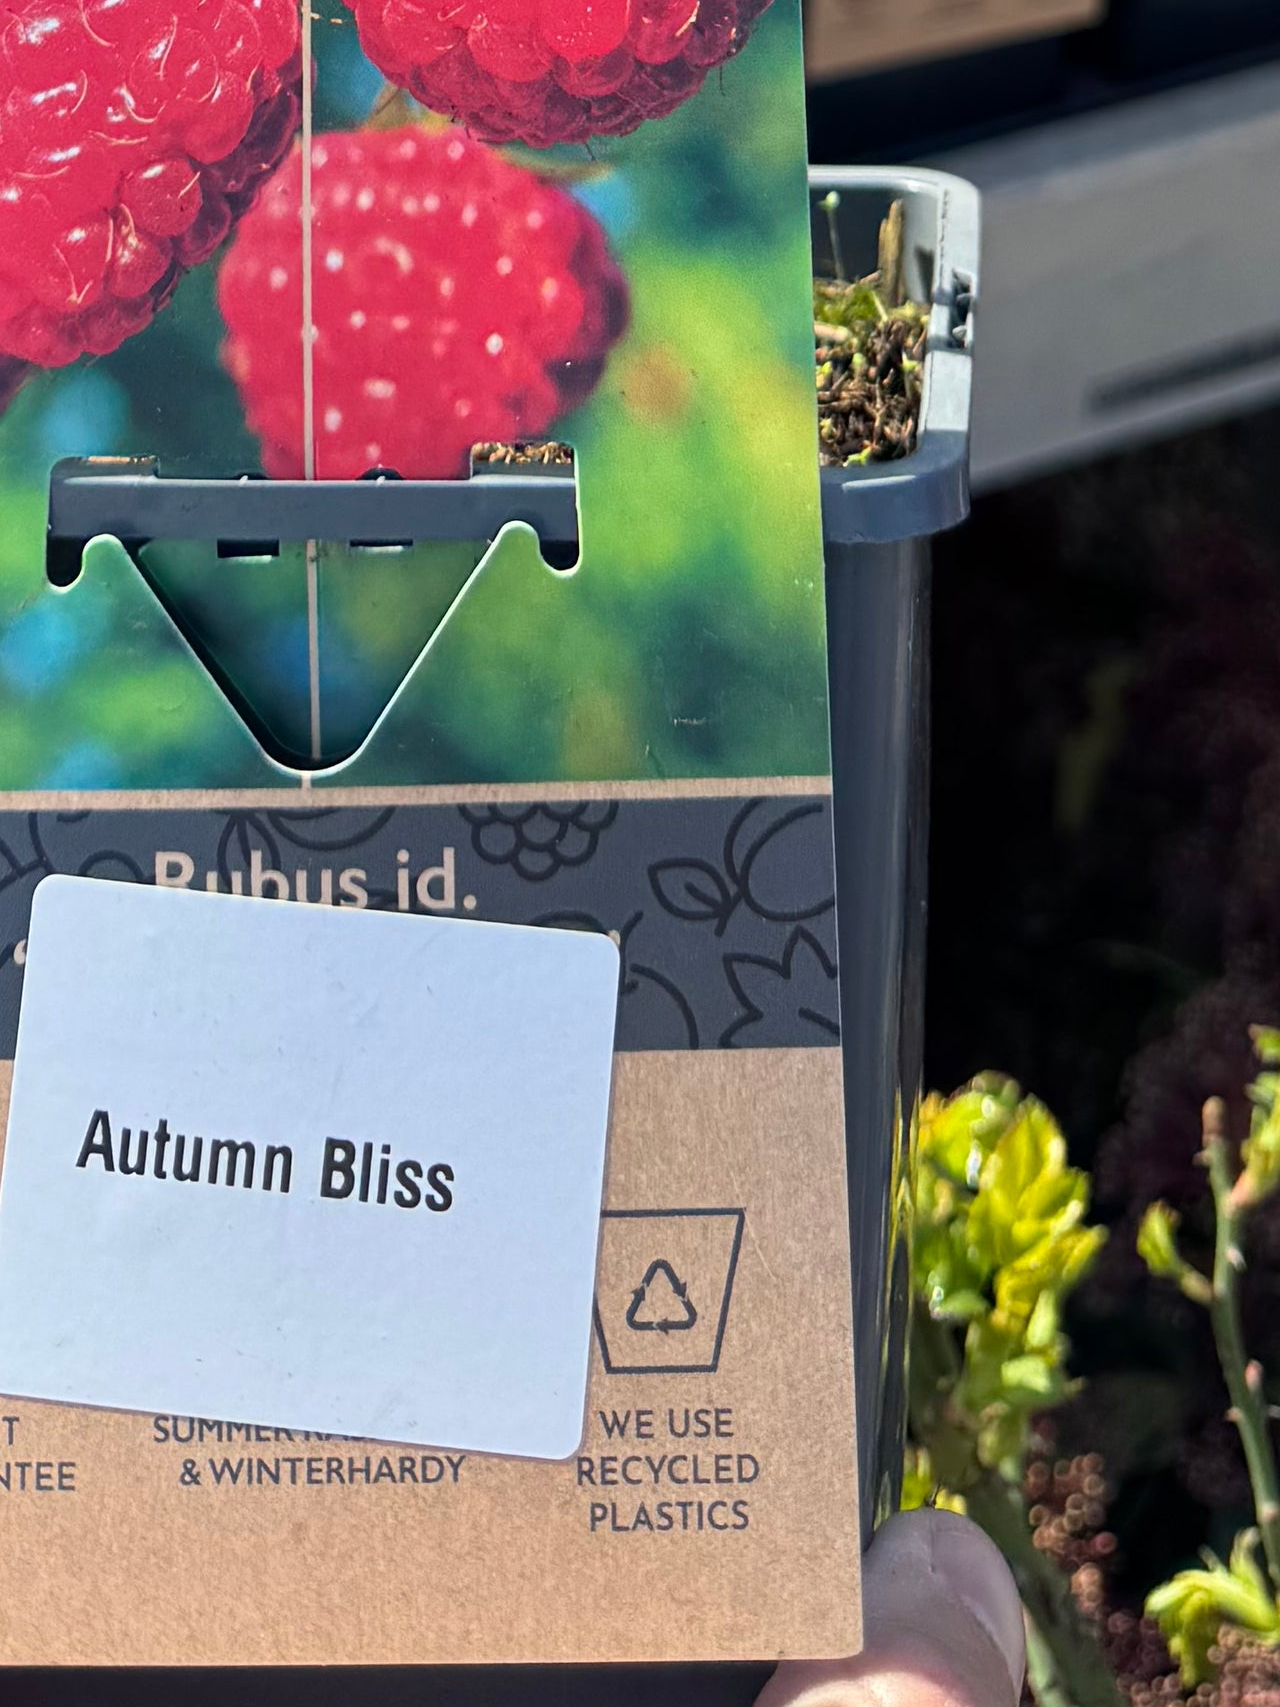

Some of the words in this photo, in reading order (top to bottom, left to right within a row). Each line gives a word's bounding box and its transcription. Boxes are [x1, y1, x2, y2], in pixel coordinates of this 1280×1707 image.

[397, 846, 478, 911] id.
[75, 1108, 294, 1194] Autumn
[319, 1136, 455, 1213] Bliss
[599, 1410, 654, 1439] WE
[668, 1407, 734, 1438] USE
[179, 1458, 201, 1486] &
[208, 1454, 467, 1486] WINTERHARDY
[577, 1453, 760, 1486] RECYCLED
[589, 1499, 750, 1532] PLASTICS
